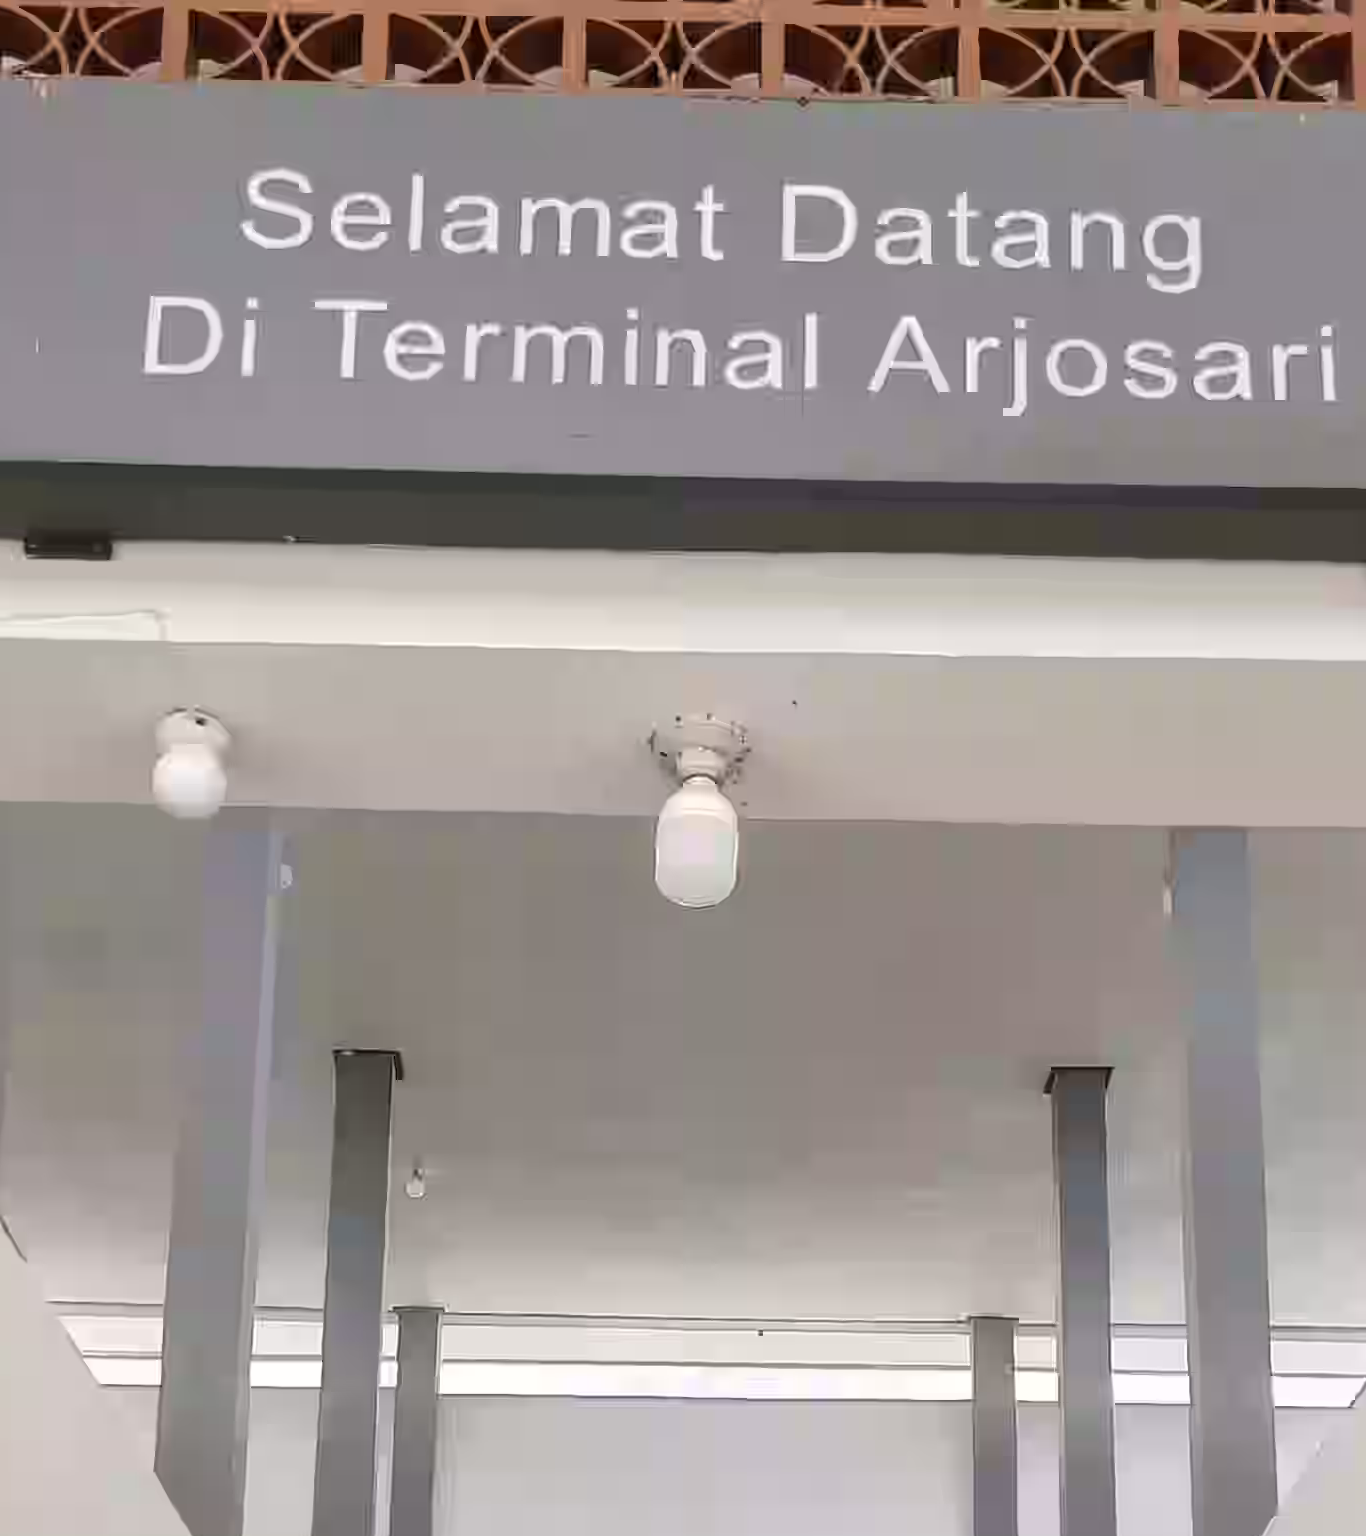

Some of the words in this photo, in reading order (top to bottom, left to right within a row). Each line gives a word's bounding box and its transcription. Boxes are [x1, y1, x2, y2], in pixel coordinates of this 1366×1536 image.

[240, 168, 725, 262] Selamat
[782, 184, 1202, 294] Datang
[143, 295, 258, 377] Di
[314, 299, 819, 390] Terminal
[867, 315, 1337, 417] Arjosari
